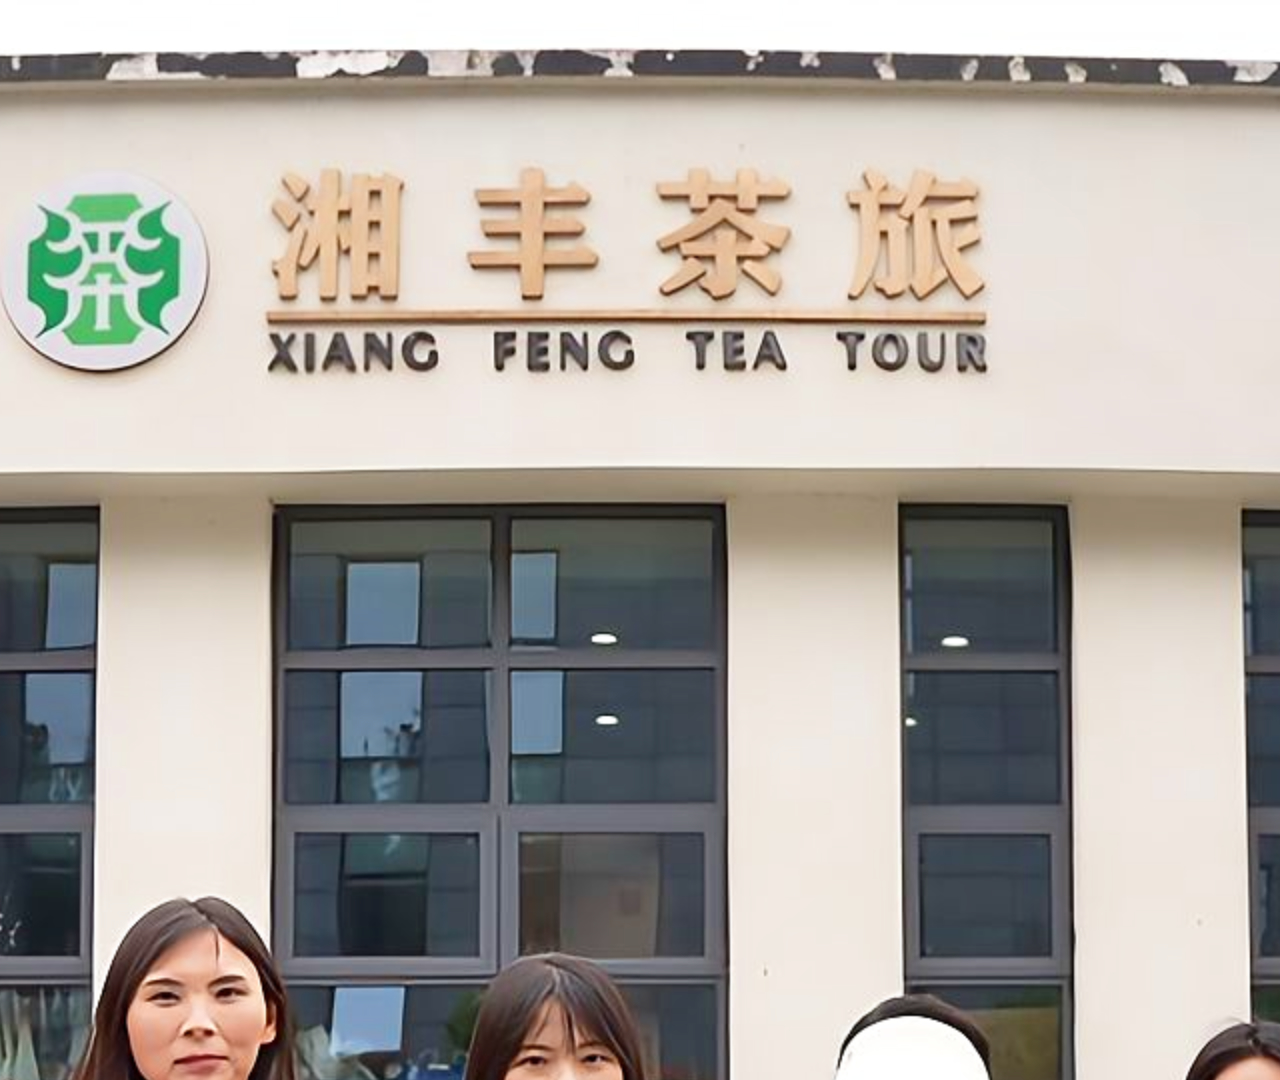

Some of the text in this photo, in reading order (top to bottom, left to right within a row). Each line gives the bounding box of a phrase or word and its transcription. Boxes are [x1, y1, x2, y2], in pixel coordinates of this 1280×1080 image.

[272, 167, 985, 300] 湘丰茶旅
[268, 330, 988, 373] XIANG FENG TEA TOUR
